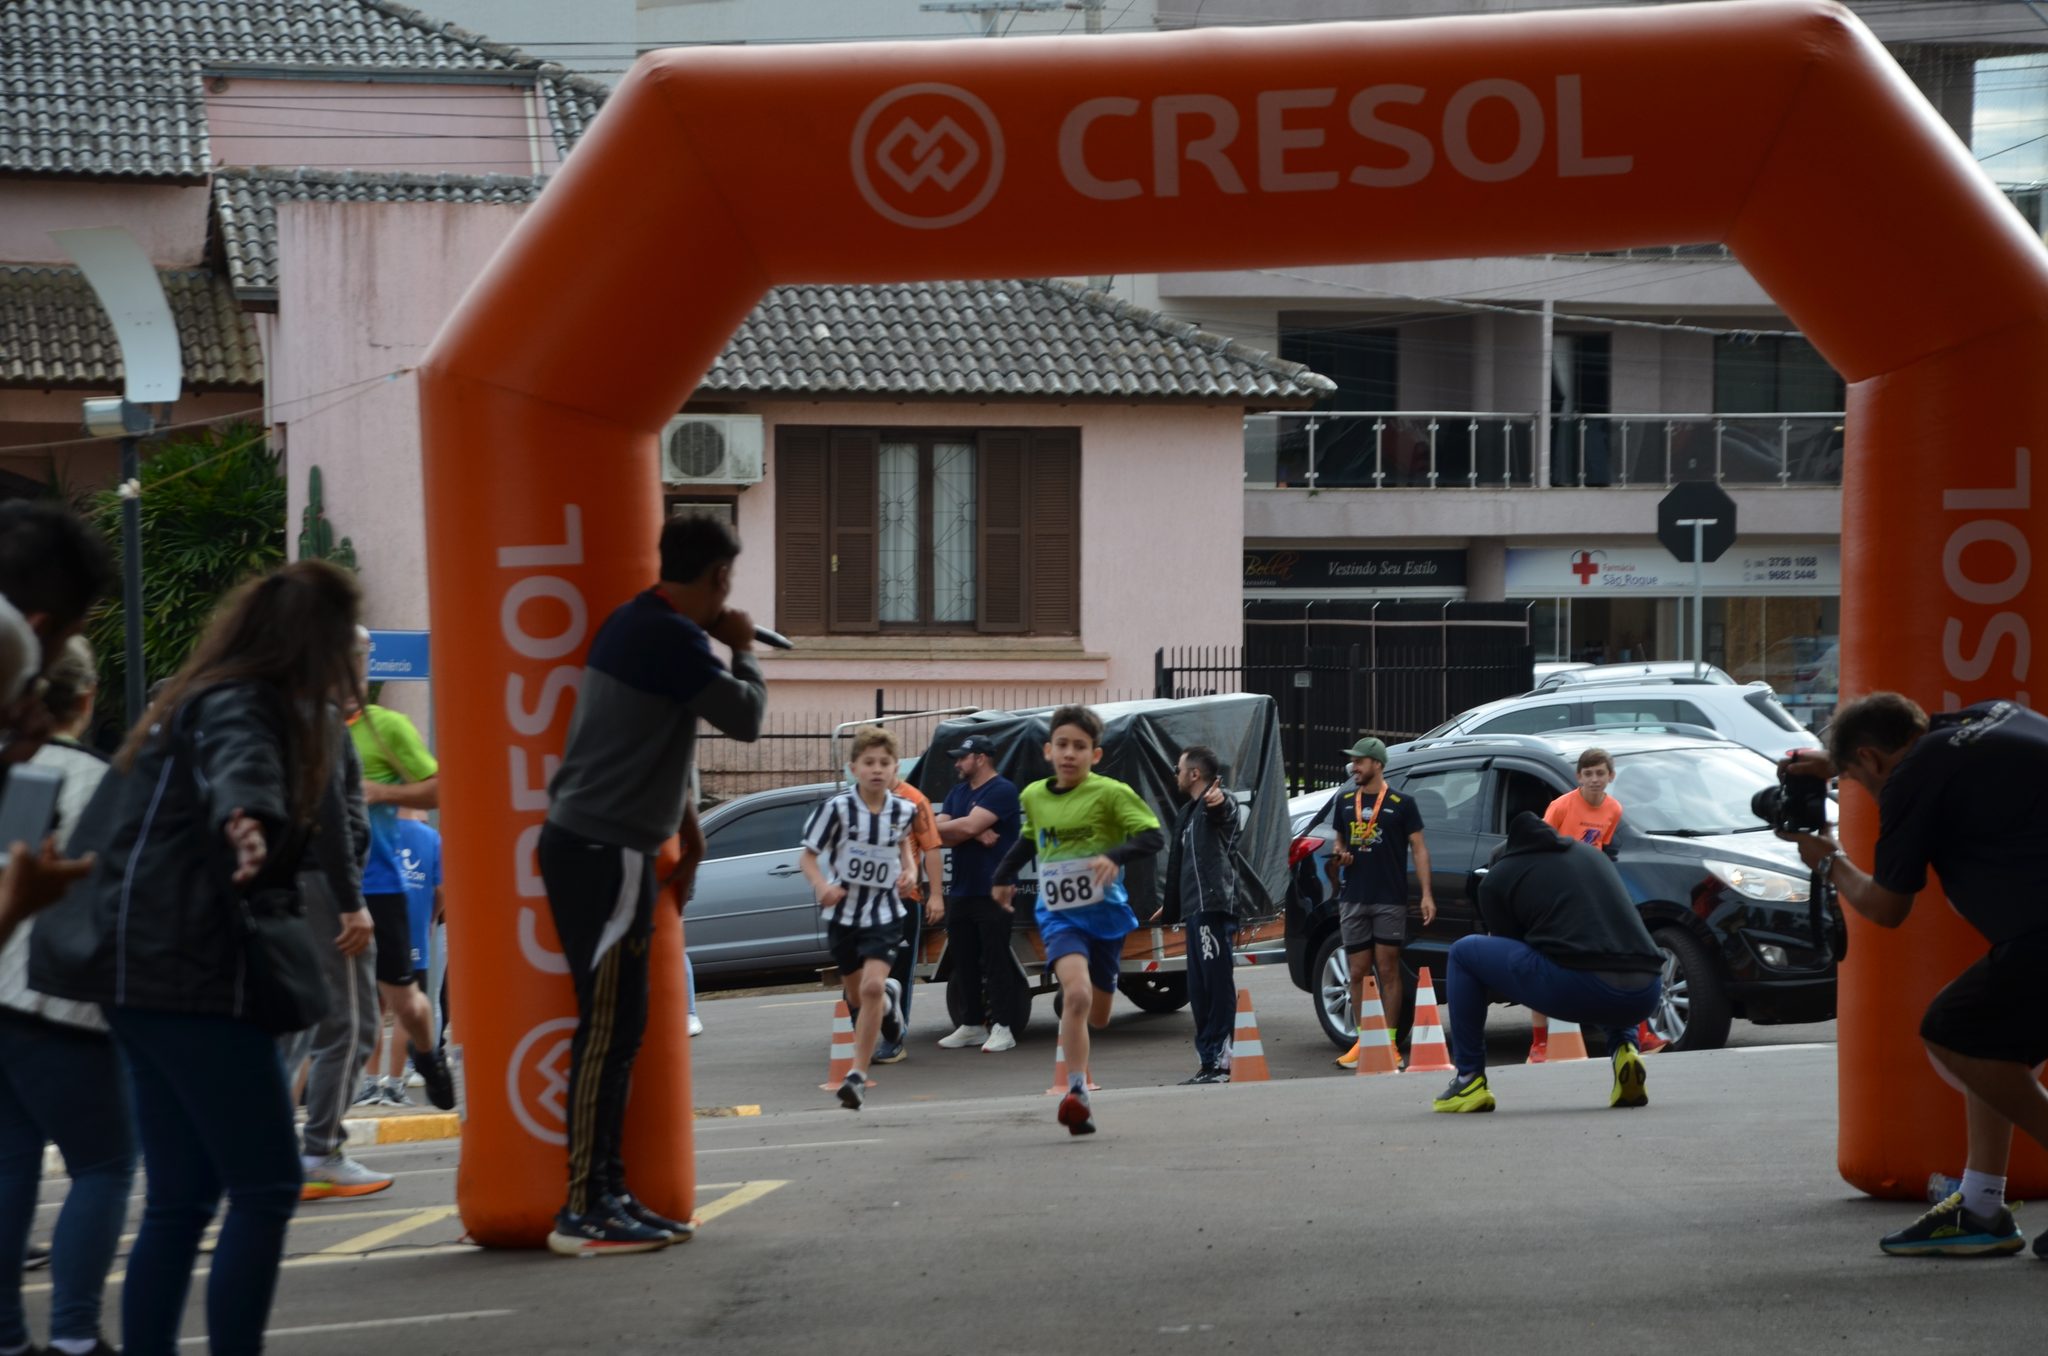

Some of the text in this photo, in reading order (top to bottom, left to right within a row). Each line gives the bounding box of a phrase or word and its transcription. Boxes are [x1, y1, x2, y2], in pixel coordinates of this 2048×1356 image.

[1057, 73, 1634, 201] CRESOL
[1328, 560, 1438, 576] Vestindo Seu Estilo
[1625, 575, 1658, 587] Roque
[847, 858, 889, 883] 990
[1045, 875, 1093, 905] 968
